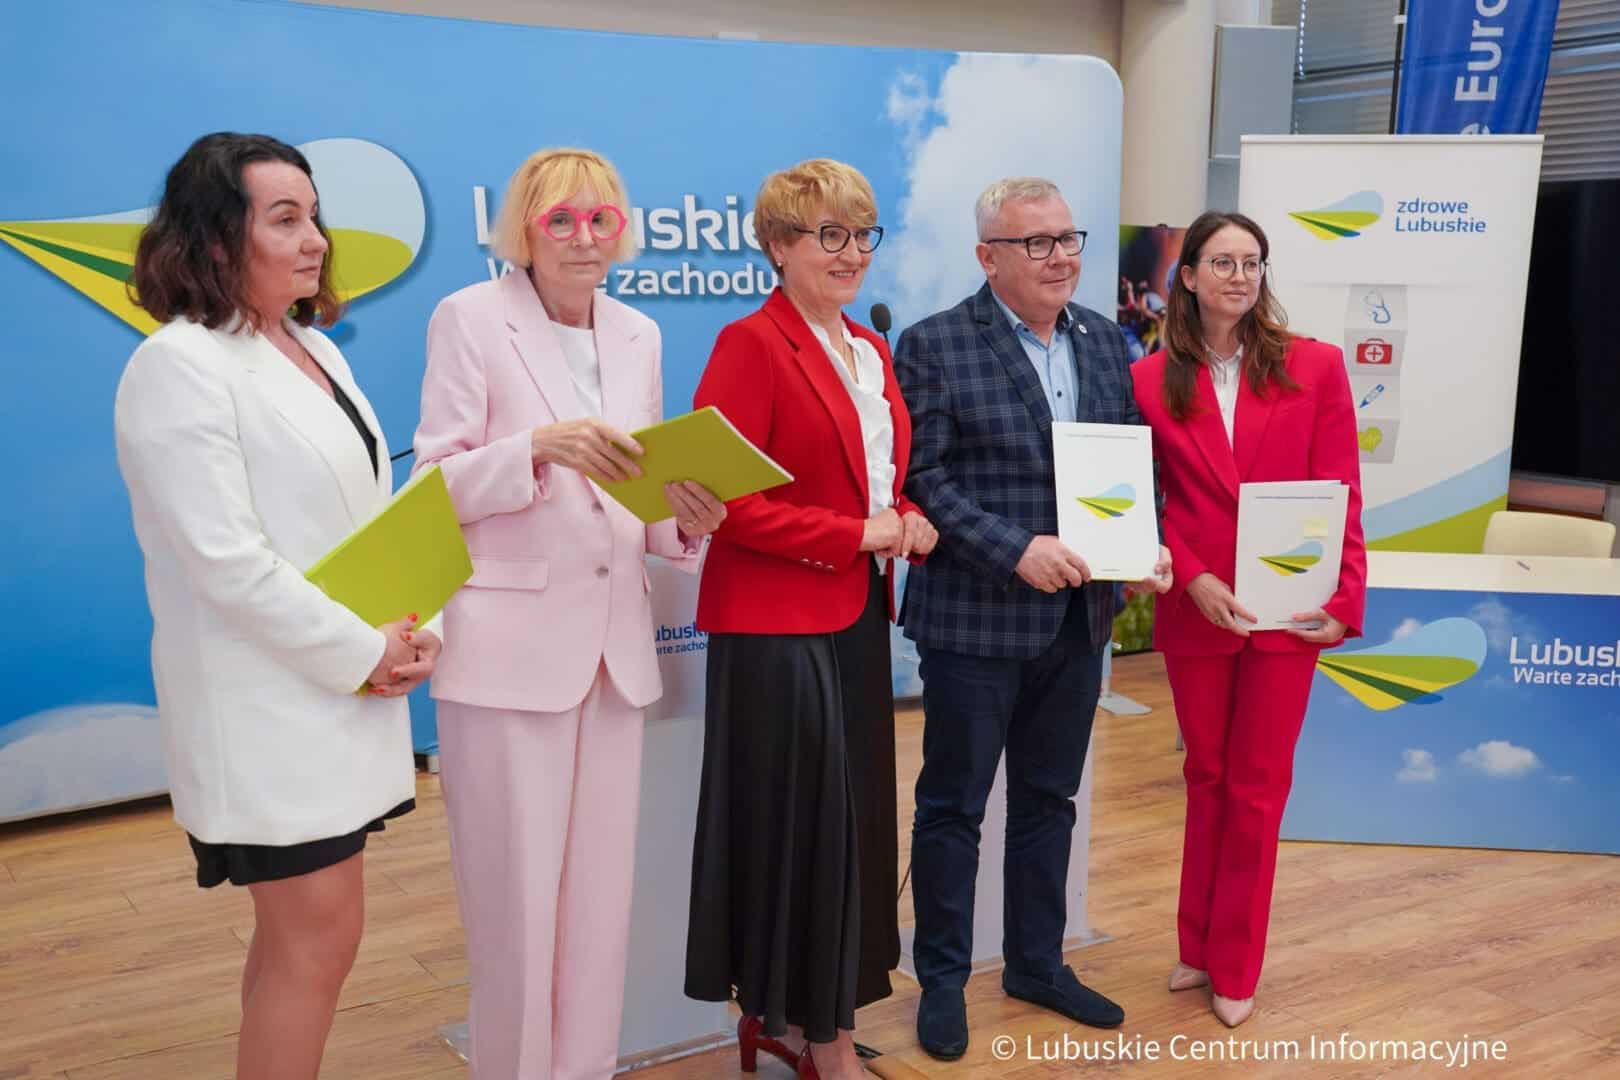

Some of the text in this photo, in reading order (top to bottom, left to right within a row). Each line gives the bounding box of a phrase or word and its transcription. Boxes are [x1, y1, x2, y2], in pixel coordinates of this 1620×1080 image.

[1397, 198, 1468, 213] zdrowe
[473, 186, 761, 250] Lski
[1395, 216, 1486, 232] Lubuskie
[616, 262, 778, 295] zachodu
[675, 641, 705, 653] zacho
[1513, 667, 1572, 684] Warte
